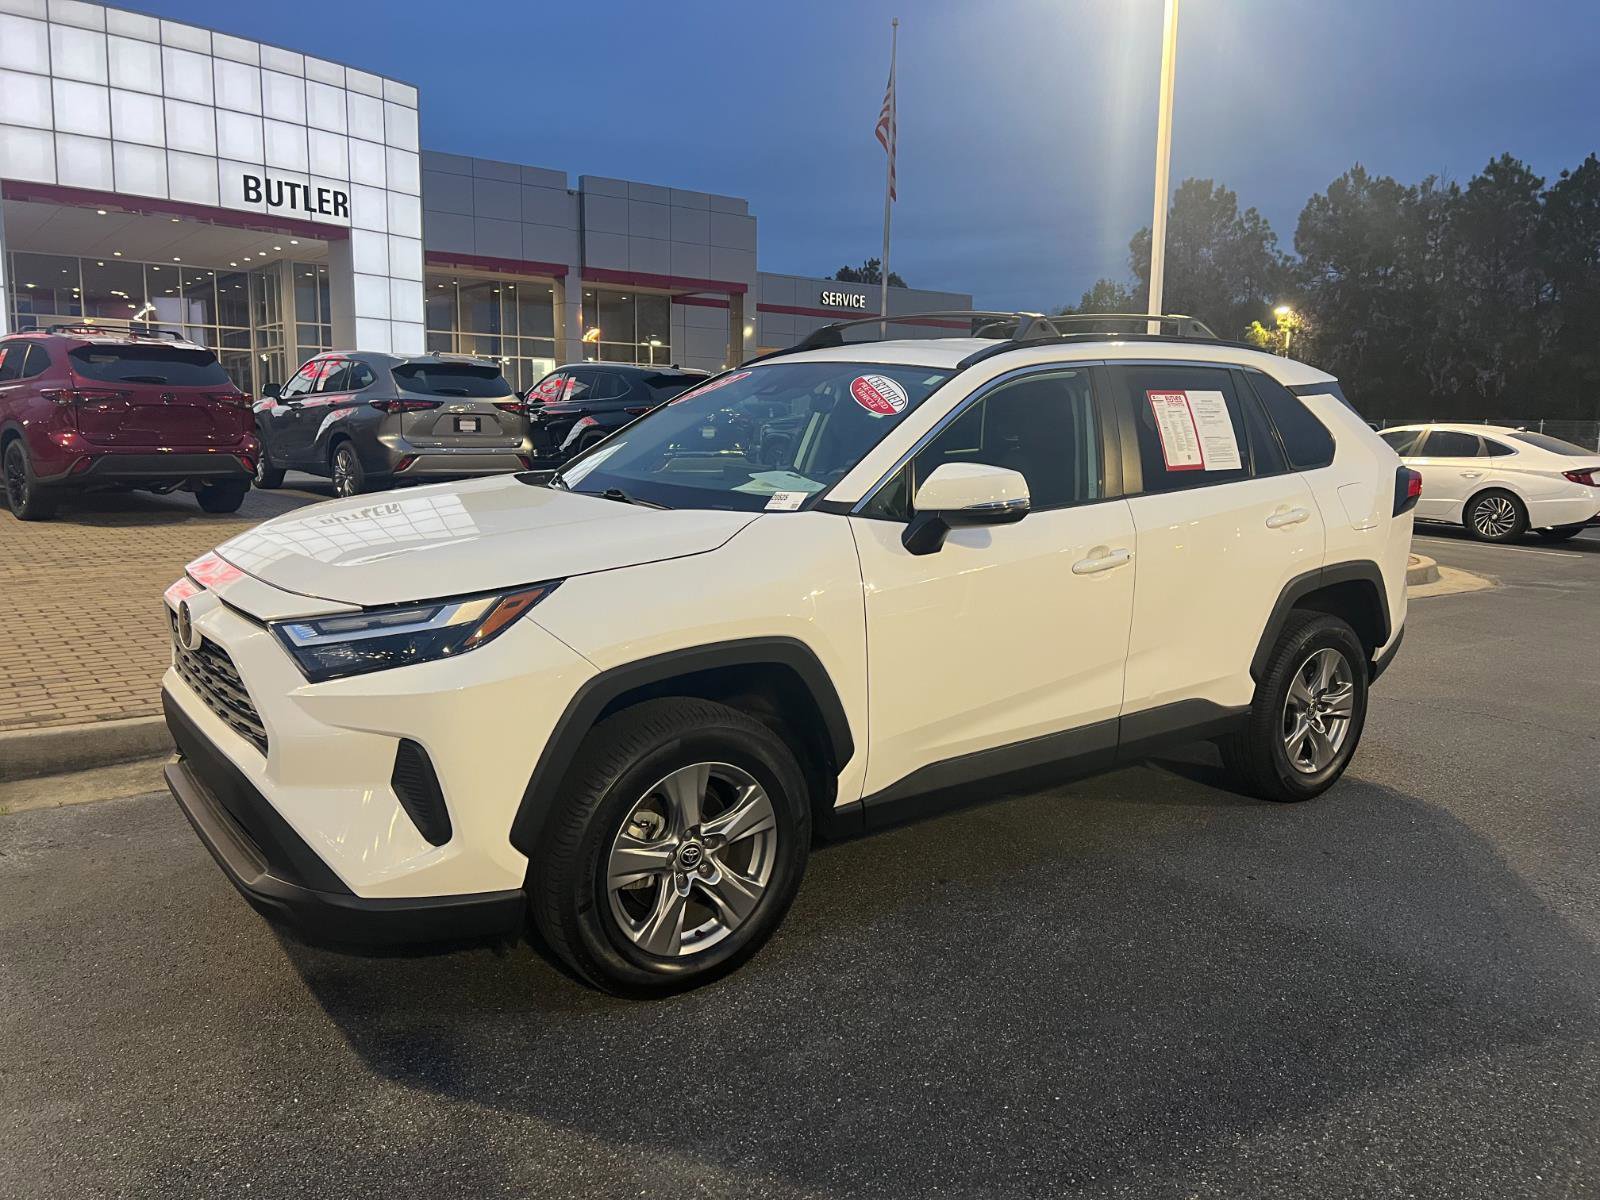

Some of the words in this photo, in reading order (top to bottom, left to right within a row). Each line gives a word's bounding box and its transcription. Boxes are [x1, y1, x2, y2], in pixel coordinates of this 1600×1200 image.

[243, 174, 349, 218] BUTLER
[822, 291, 866, 309] SERVICE
[856, 387, 878, 409] VEHICLE
[867, 376, 904, 406] CERTIFIED
